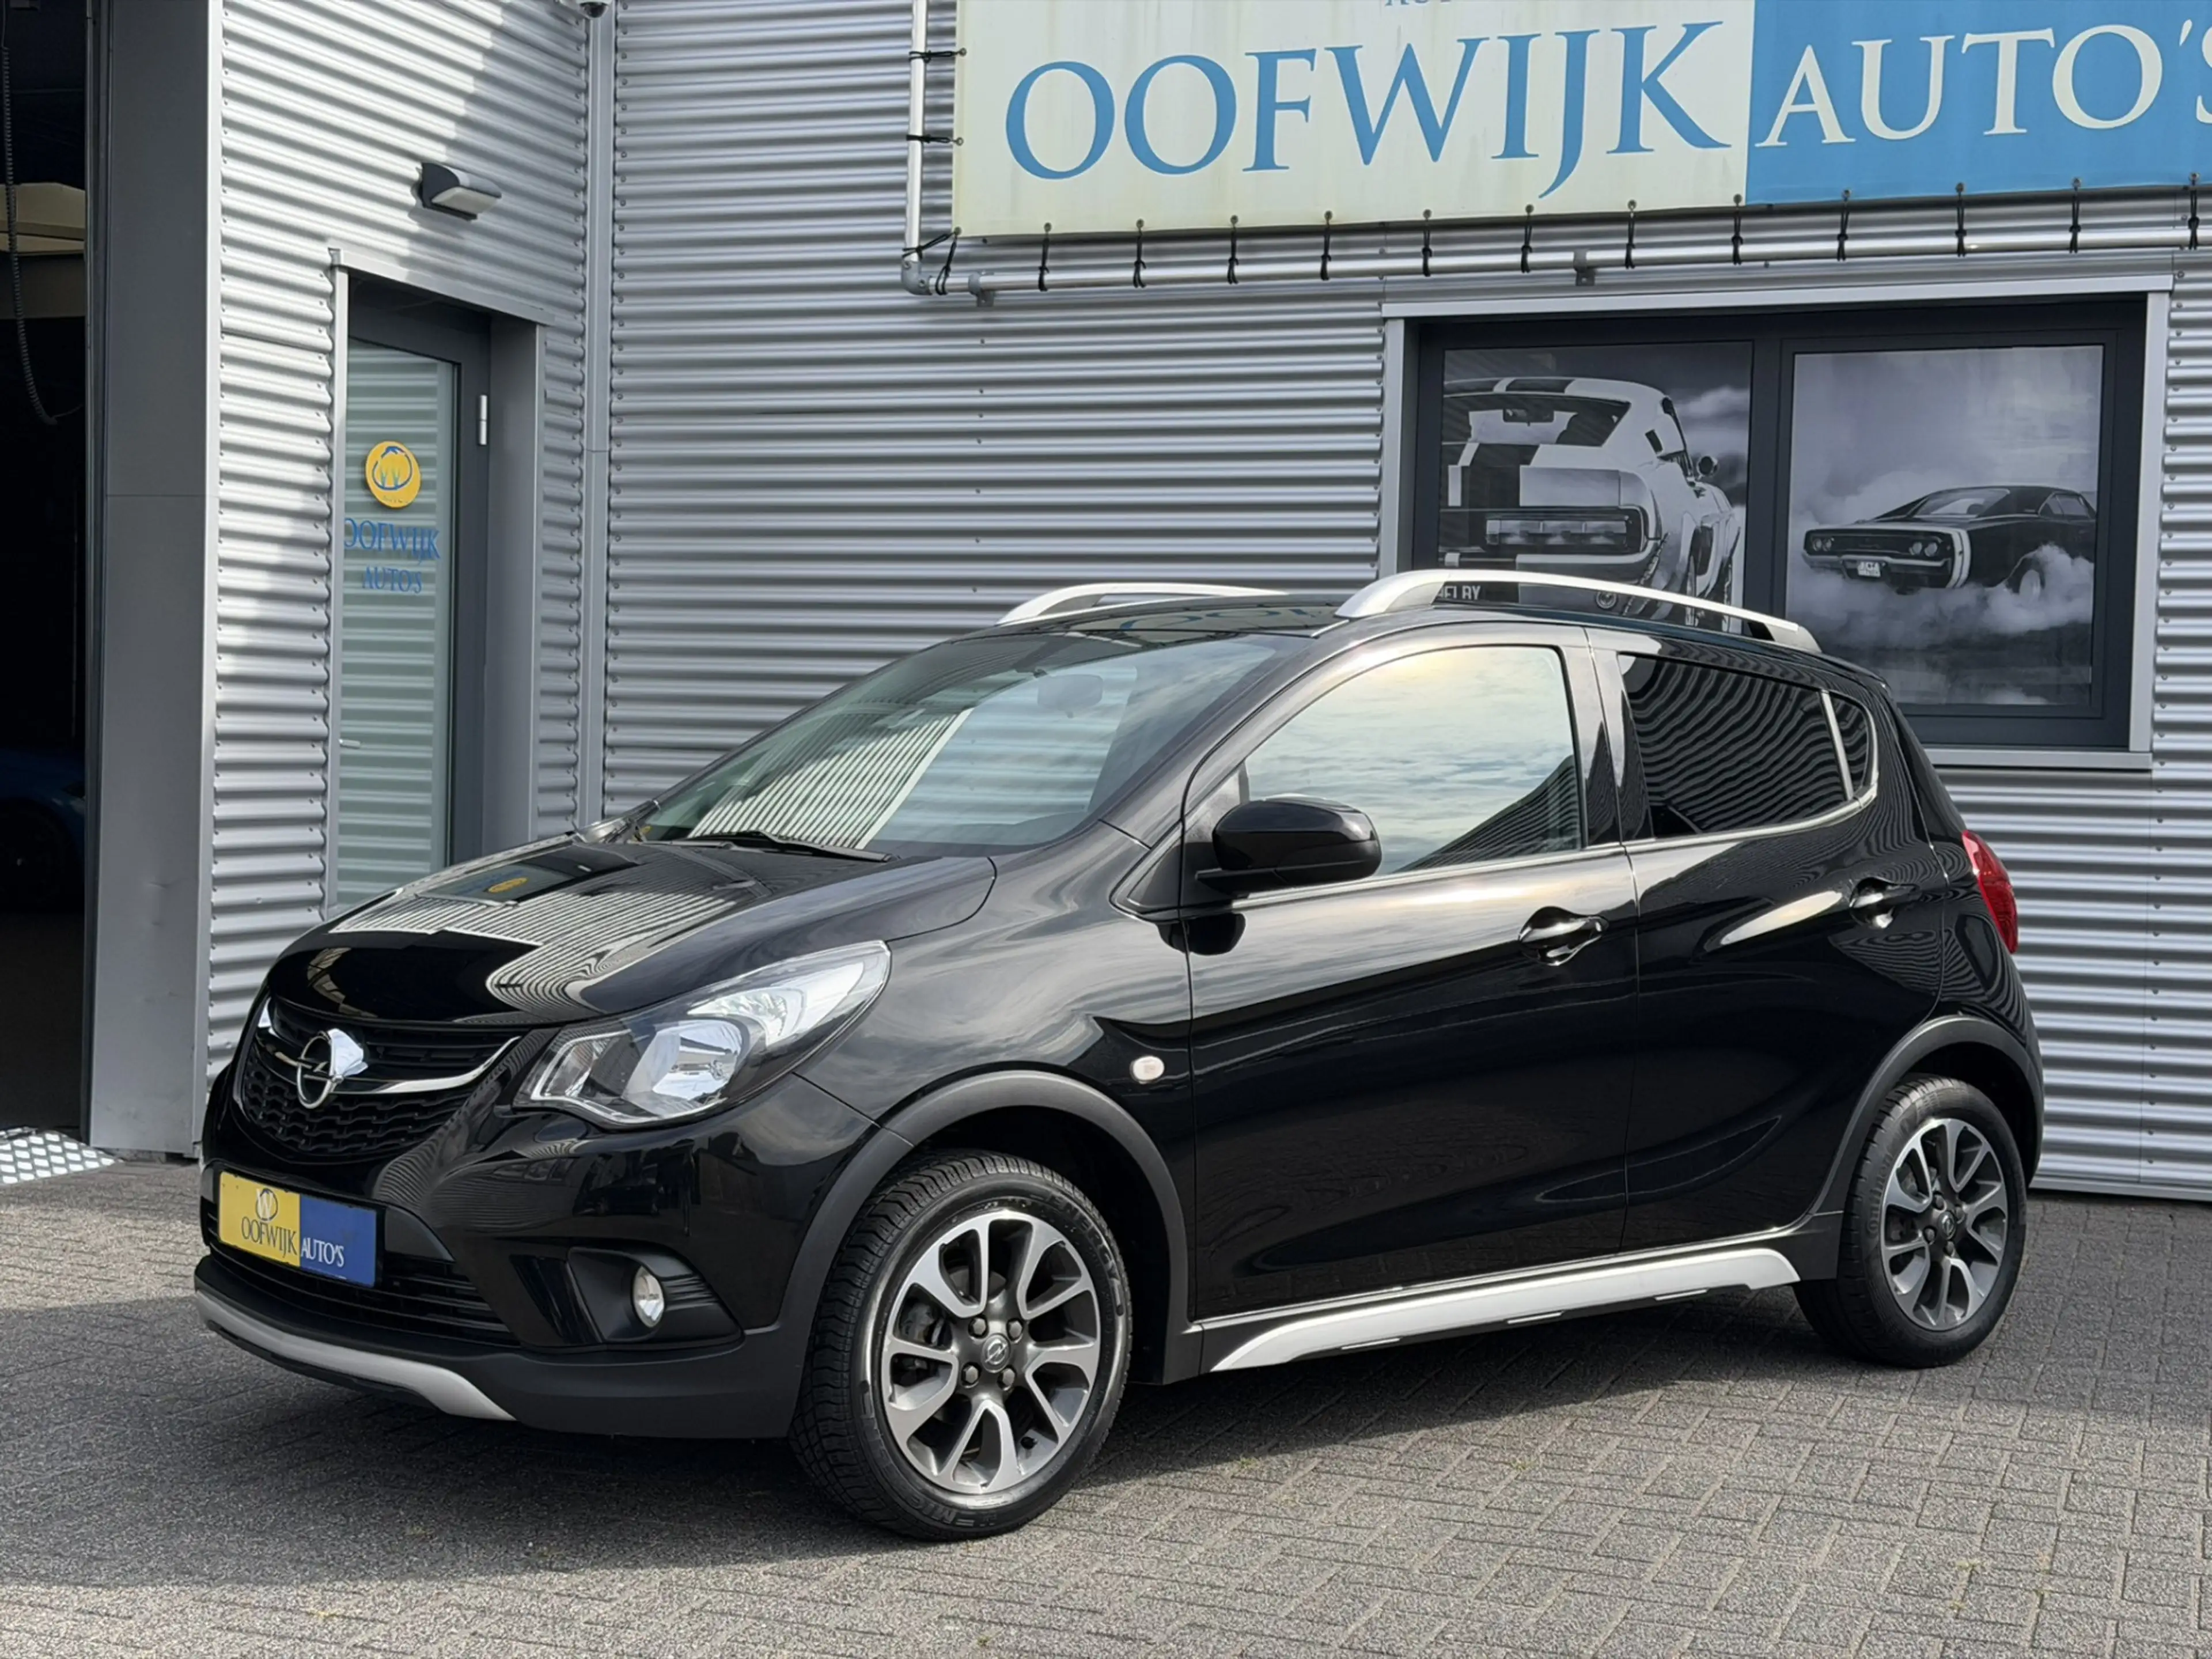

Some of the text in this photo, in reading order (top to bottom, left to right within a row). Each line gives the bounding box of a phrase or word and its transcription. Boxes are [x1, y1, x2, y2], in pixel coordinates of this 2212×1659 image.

[1005, 21, 1732, 198] OOFWIJK
[241, 1216, 344, 1267] OOFWIJK AUTO'S
[1047, 1192, 1121, 1280] ENERGY
